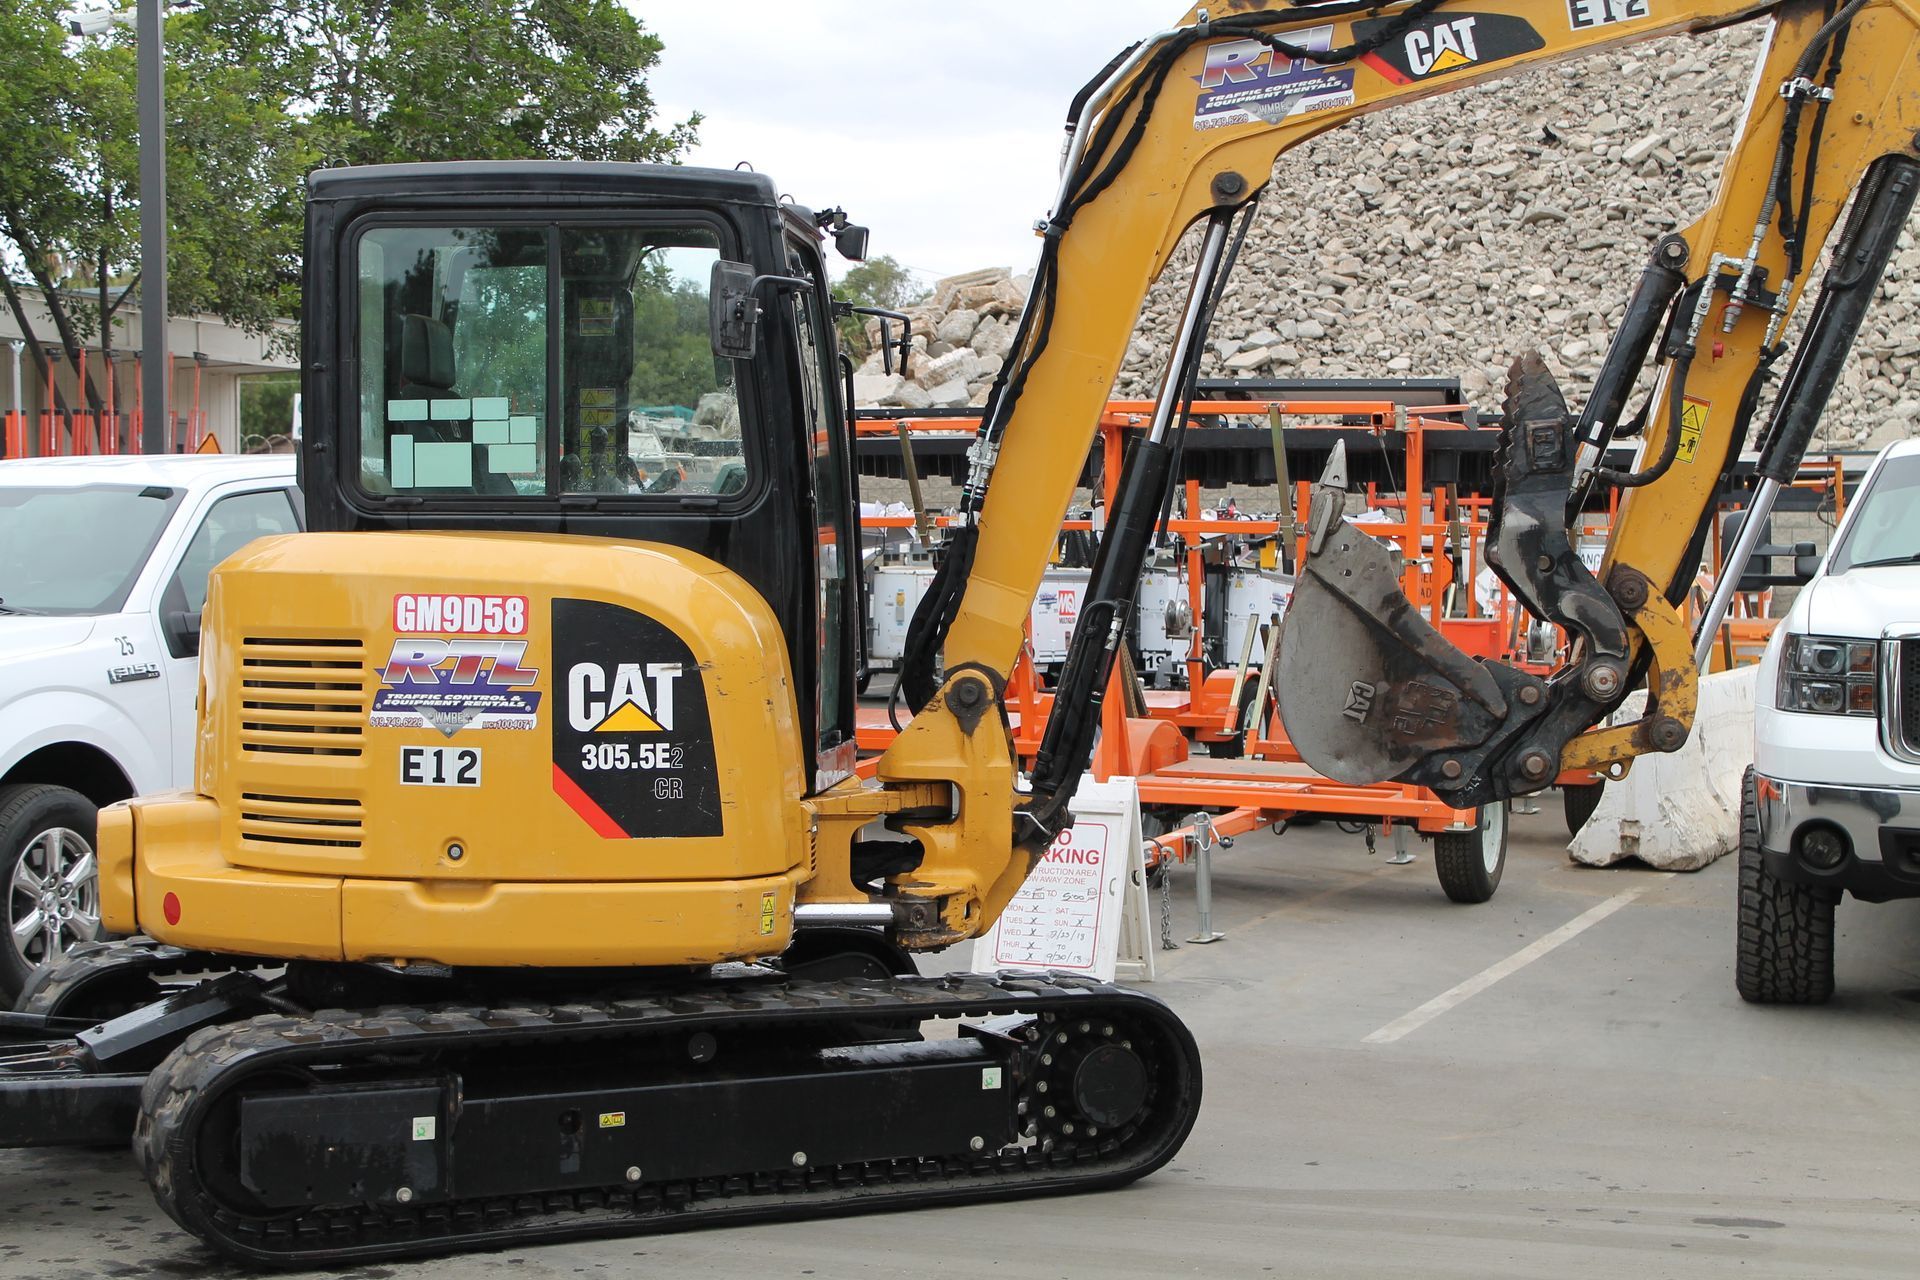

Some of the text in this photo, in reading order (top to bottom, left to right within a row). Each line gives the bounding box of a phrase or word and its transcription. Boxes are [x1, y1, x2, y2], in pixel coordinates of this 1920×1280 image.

[1404, 16, 1477, 76] CAT
[1201, 24, 1346, 88] RTL
[1205, 80, 1342, 109] EQUIPMENT RENTALS
[1208, 75, 1337, 102] TRAFFIC CONTROL &
[1258, 103, 1287, 116] WMBE
[397, 595, 524, 633] GM9D58
[114, 636, 135, 656] 25
[381, 638, 540, 686] RTL
[463, 700, 526, 708] RENTALS
[568, 662, 683, 733] CAT
[1342, 680, 1376, 724] CAT
[369, 716, 423, 728] 619.749.6228
[435, 712, 464, 725] WMBE
[581, 743, 684, 770] 305.5E2
[402, 748, 478, 785] E12
[654, 777, 684, 800] CR
[1052, 830, 1072, 846] O
[1041, 848, 1100, 865] RKING
[1040, 876, 1063, 884] AWAY
[1064, 877, 1086, 885] ZONE
[1075, 868, 1098, 877] AREA
[1046, 889, 1057, 898] TO
[1006, 916, 1023, 924] TUES
[1004, 928, 1022, 936] WED
[1000, 952, 1013, 960] FRI
